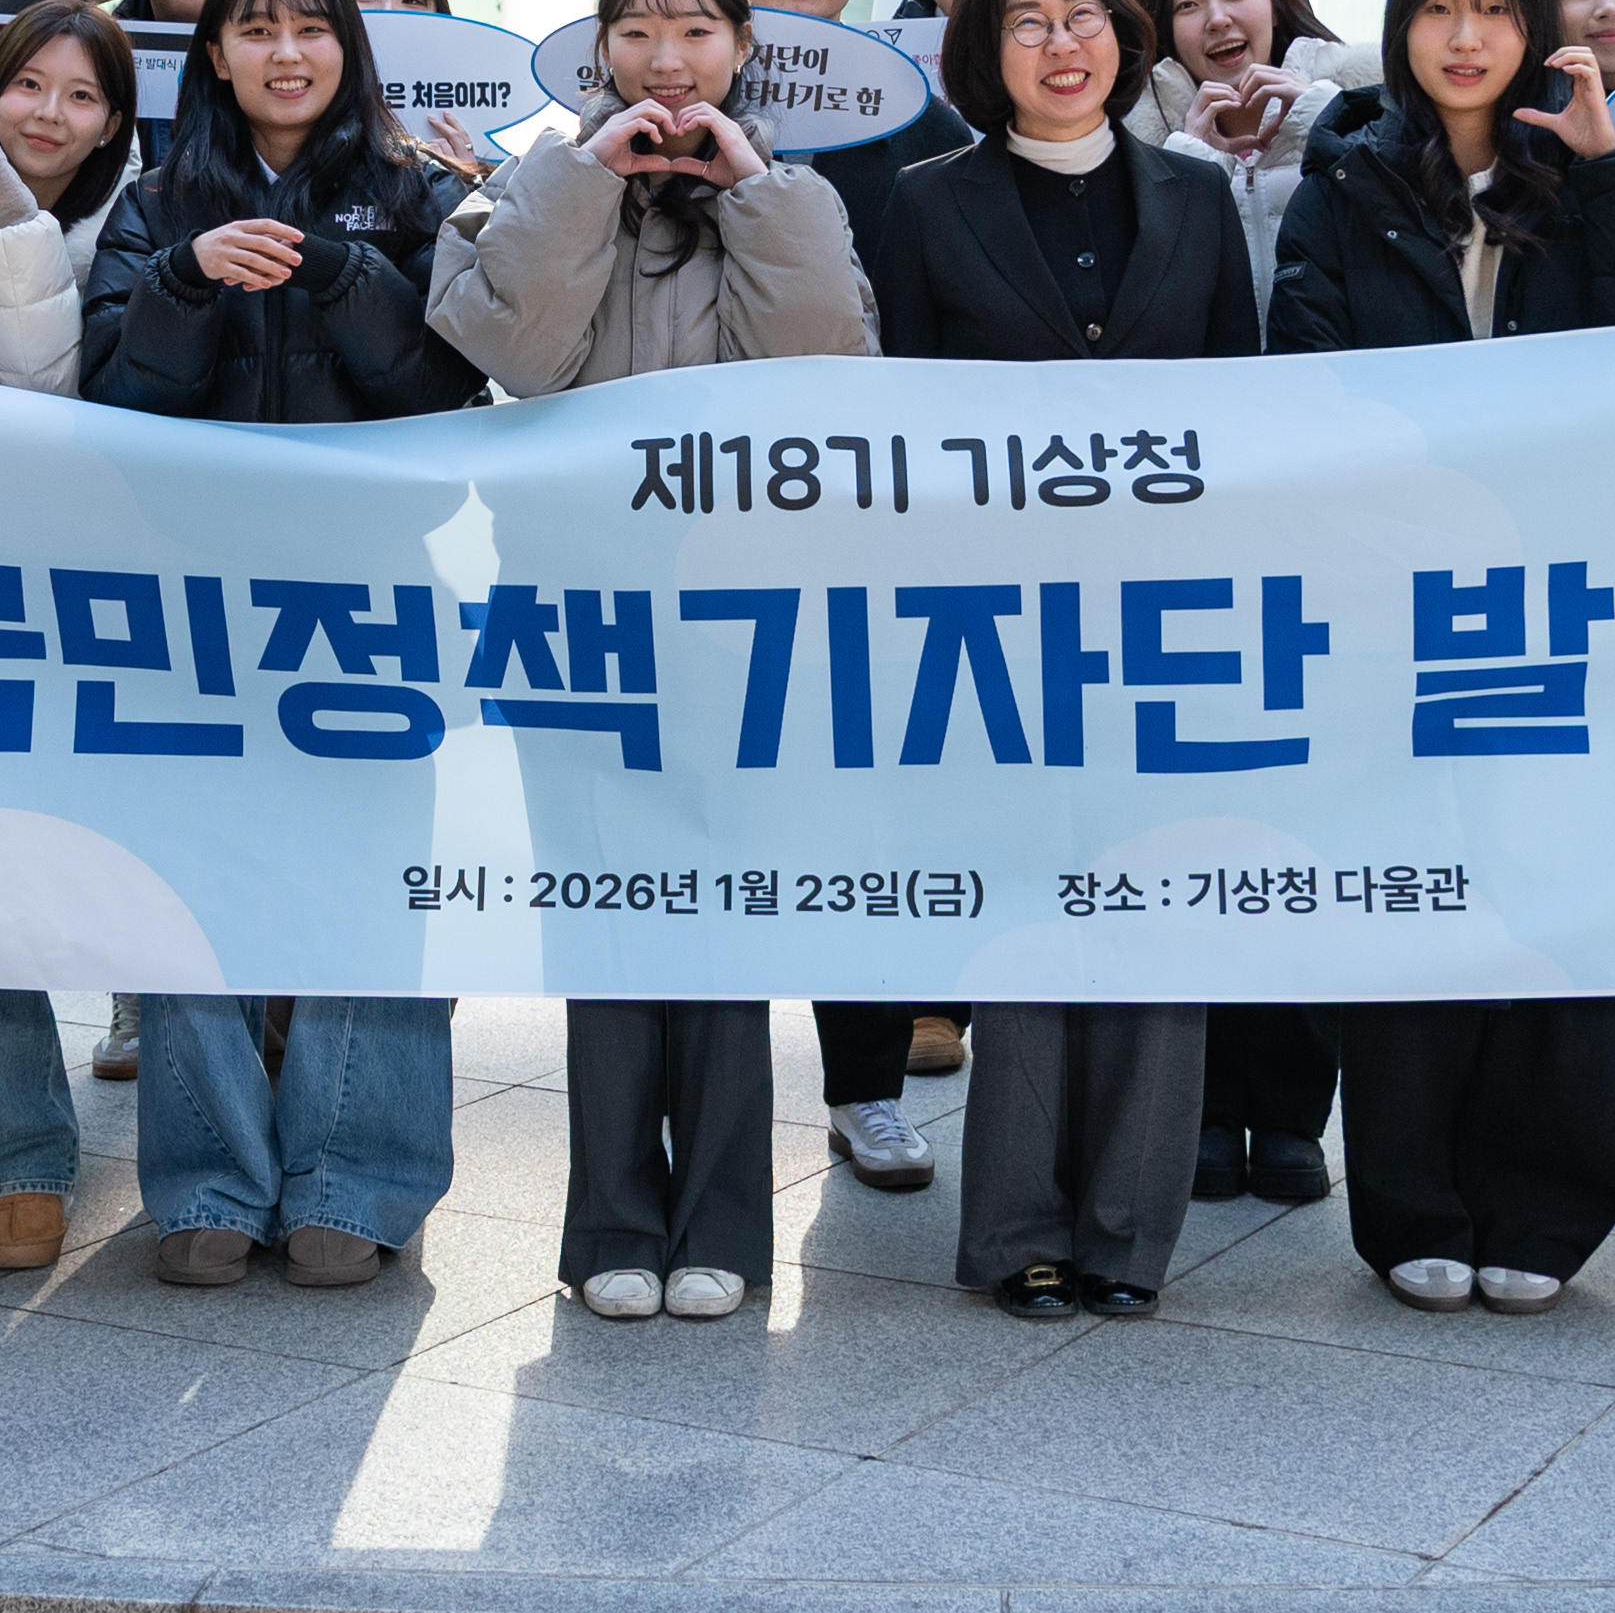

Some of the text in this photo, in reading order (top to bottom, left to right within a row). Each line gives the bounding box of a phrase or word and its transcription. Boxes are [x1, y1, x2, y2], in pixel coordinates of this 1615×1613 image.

[412, 81, 511, 109] 처음이지?
[856, 87, 885, 117] 함
[630, 429, 1205, 514] 제18기 기상청
[402, 865, 485, 912] 일시
[529, 868, 699, 915] 2026년
[715, 869, 779, 916] 1월
[795, 869, 984, 919] 23일(금)
[1057, 871, 1147, 917] 장소
[1186, 866, 1318, 915] 기상청
[1334, 864, 1470, 914] 다울관
